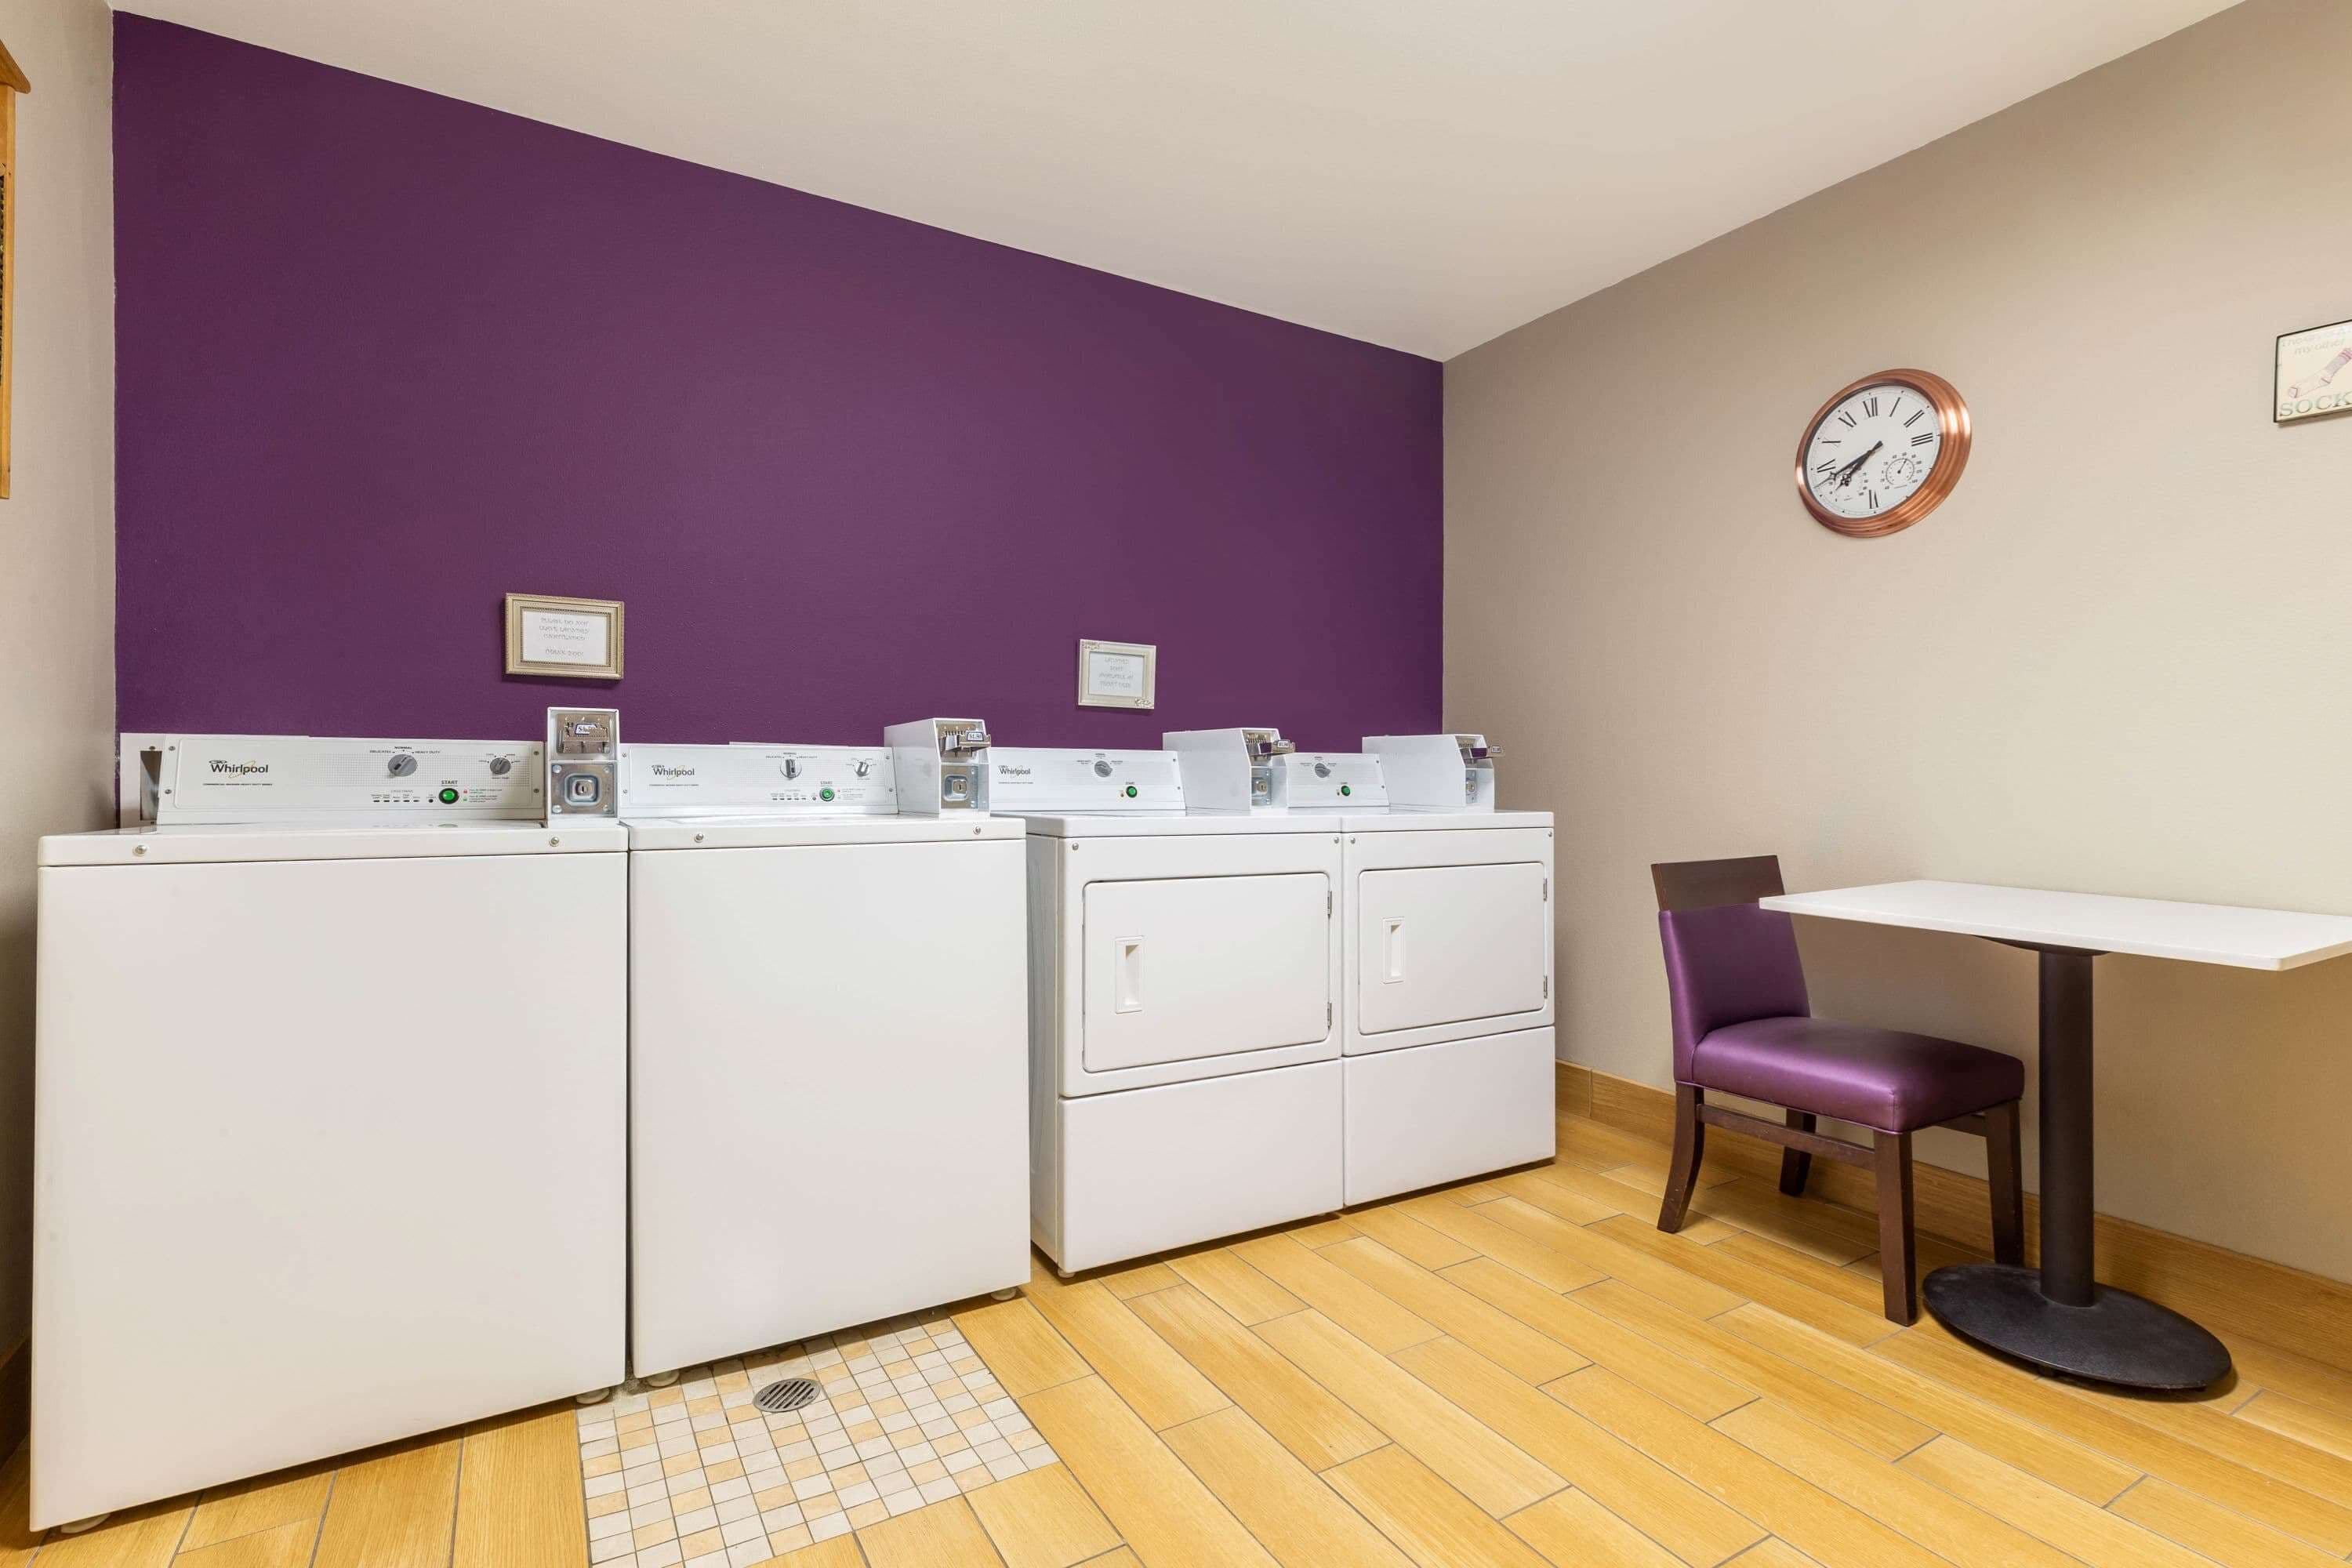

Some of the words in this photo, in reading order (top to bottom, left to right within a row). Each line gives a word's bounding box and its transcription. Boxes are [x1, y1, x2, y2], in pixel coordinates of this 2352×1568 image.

[210, 764, 269, 775] Whirlpool
[652, 768, 695, 778] Whirlpool
[1000, 768, 1031, 776] Whirlpool
